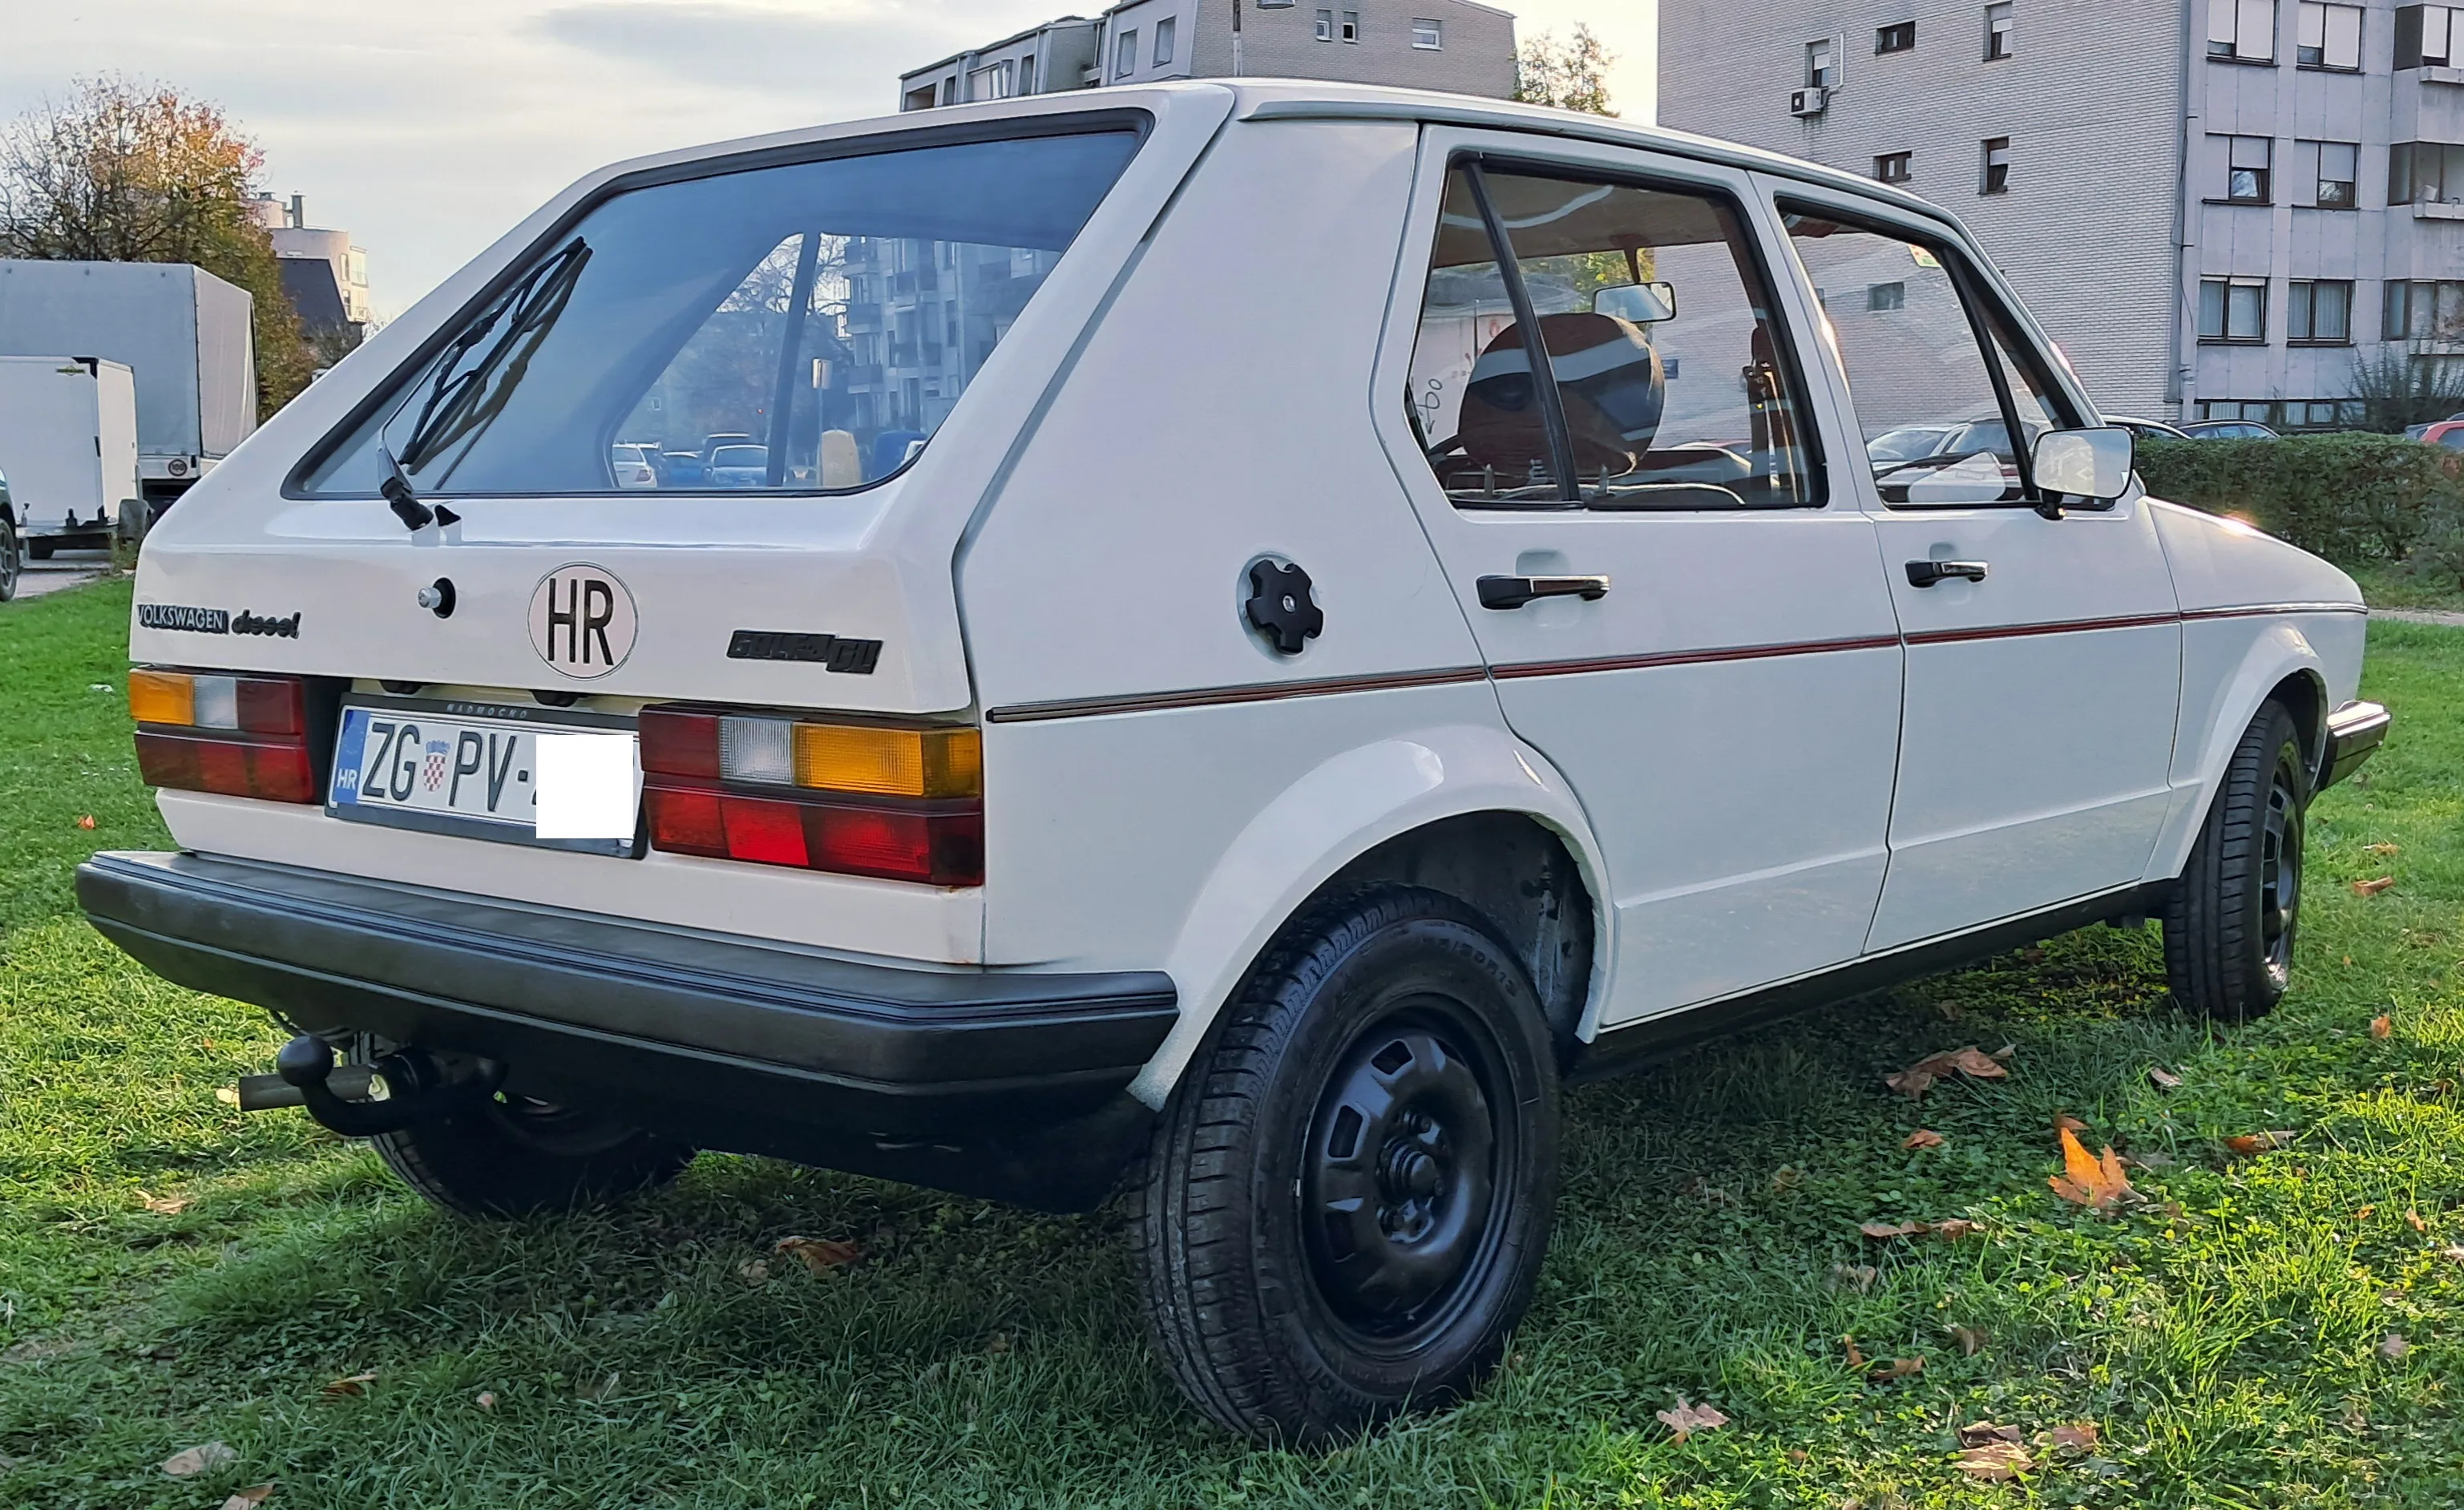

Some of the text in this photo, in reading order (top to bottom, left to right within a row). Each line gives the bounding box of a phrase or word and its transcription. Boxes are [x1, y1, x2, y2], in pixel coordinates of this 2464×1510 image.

[137, 604, 301, 640] VOLKSWAGEN diesel
[547, 577, 615, 666] HR
[336, 768, 358, 790] HR
[362, 722, 421, 801] ZG
